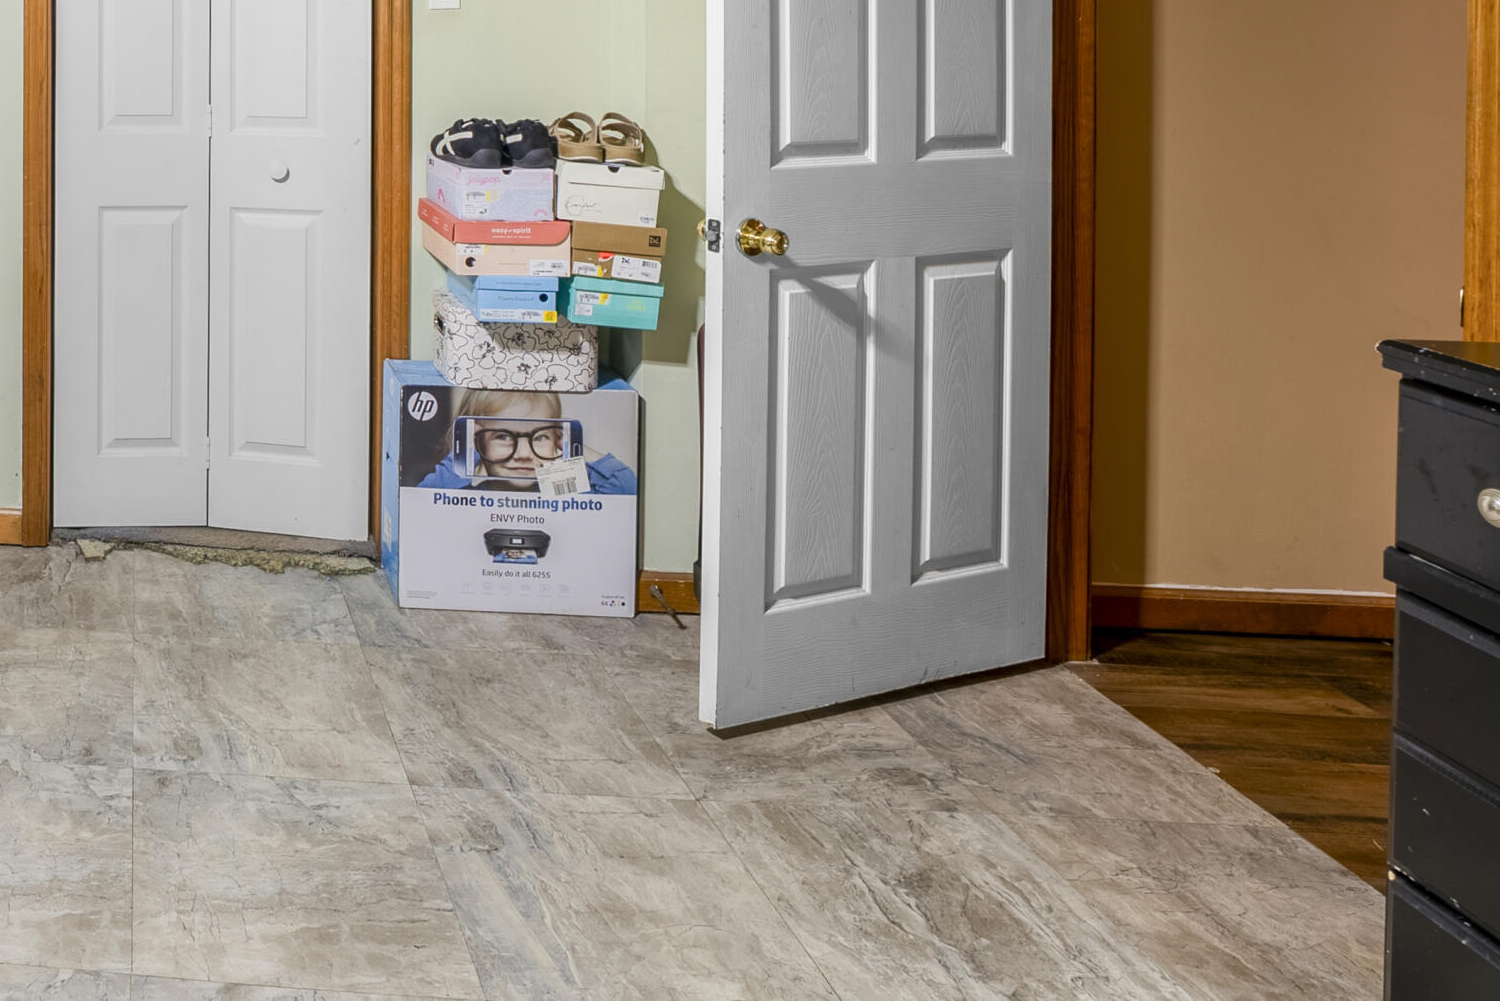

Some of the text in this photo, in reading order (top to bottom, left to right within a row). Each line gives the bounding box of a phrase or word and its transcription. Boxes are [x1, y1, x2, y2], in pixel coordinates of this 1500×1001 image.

[410, 391, 436, 421] hp
[433, 492, 603, 513] Phone to stunning photo
[490, 513, 545, 524] ENVY Photo
[482, 569, 551, 579] Easily do it all 6255
